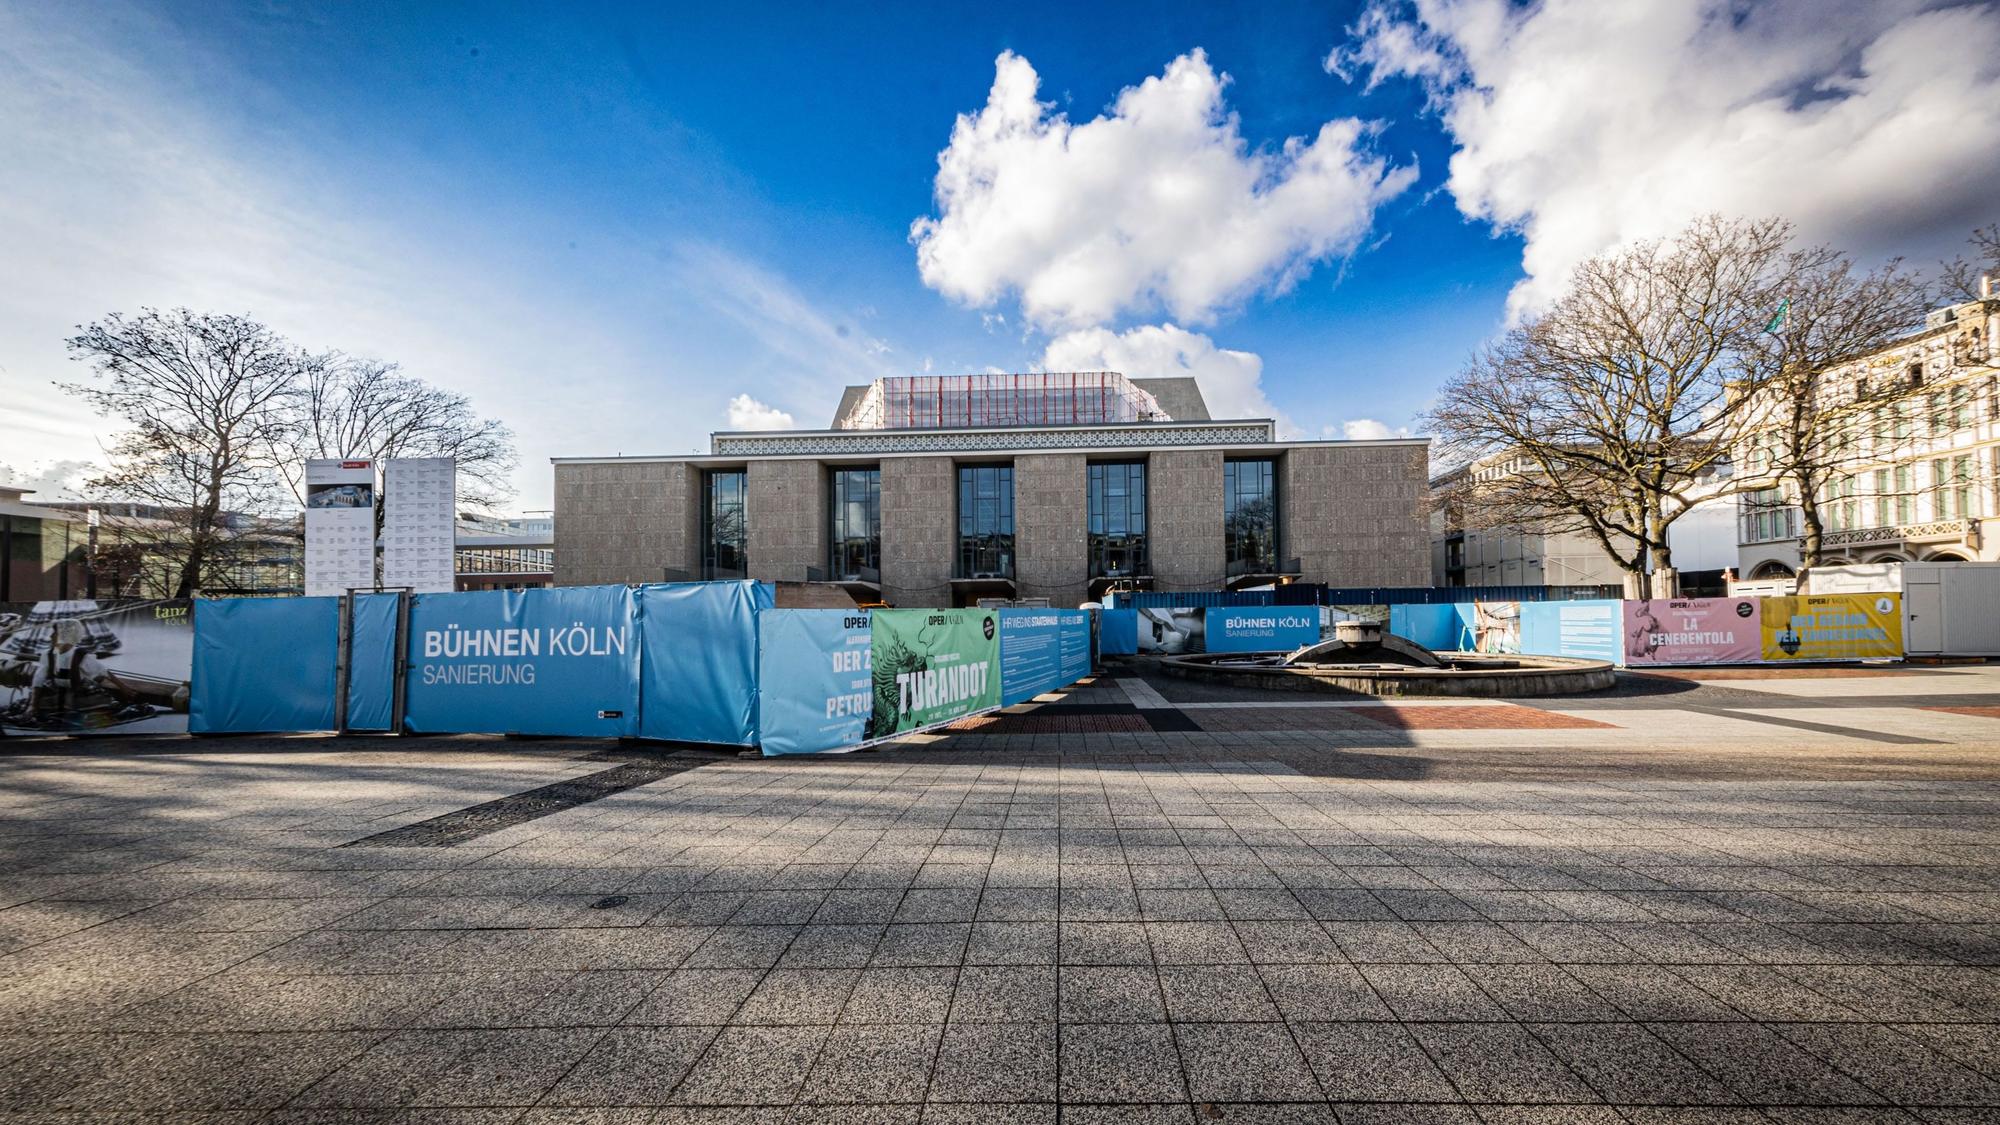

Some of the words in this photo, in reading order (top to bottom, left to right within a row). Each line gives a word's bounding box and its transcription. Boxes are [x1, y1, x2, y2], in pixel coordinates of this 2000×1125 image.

[154, 605, 188, 619] tanz
[1225, 616, 1276, 629] BÜHNEN
[1278, 616, 1310, 628] KÖLN
[1683, 618, 1698, 631] LA
[424, 624, 540, 658] BÜHNEN
[549, 621, 626, 656] KÖLN
[1225, 629, 1274, 638] SANIERUNG
[1649, 631, 1735, 646] CENERENTOLA
[832, 650, 861, 673] DER
[423, 664, 536, 685] SANIERUNG
[896, 661, 988, 714] TURANDOT
